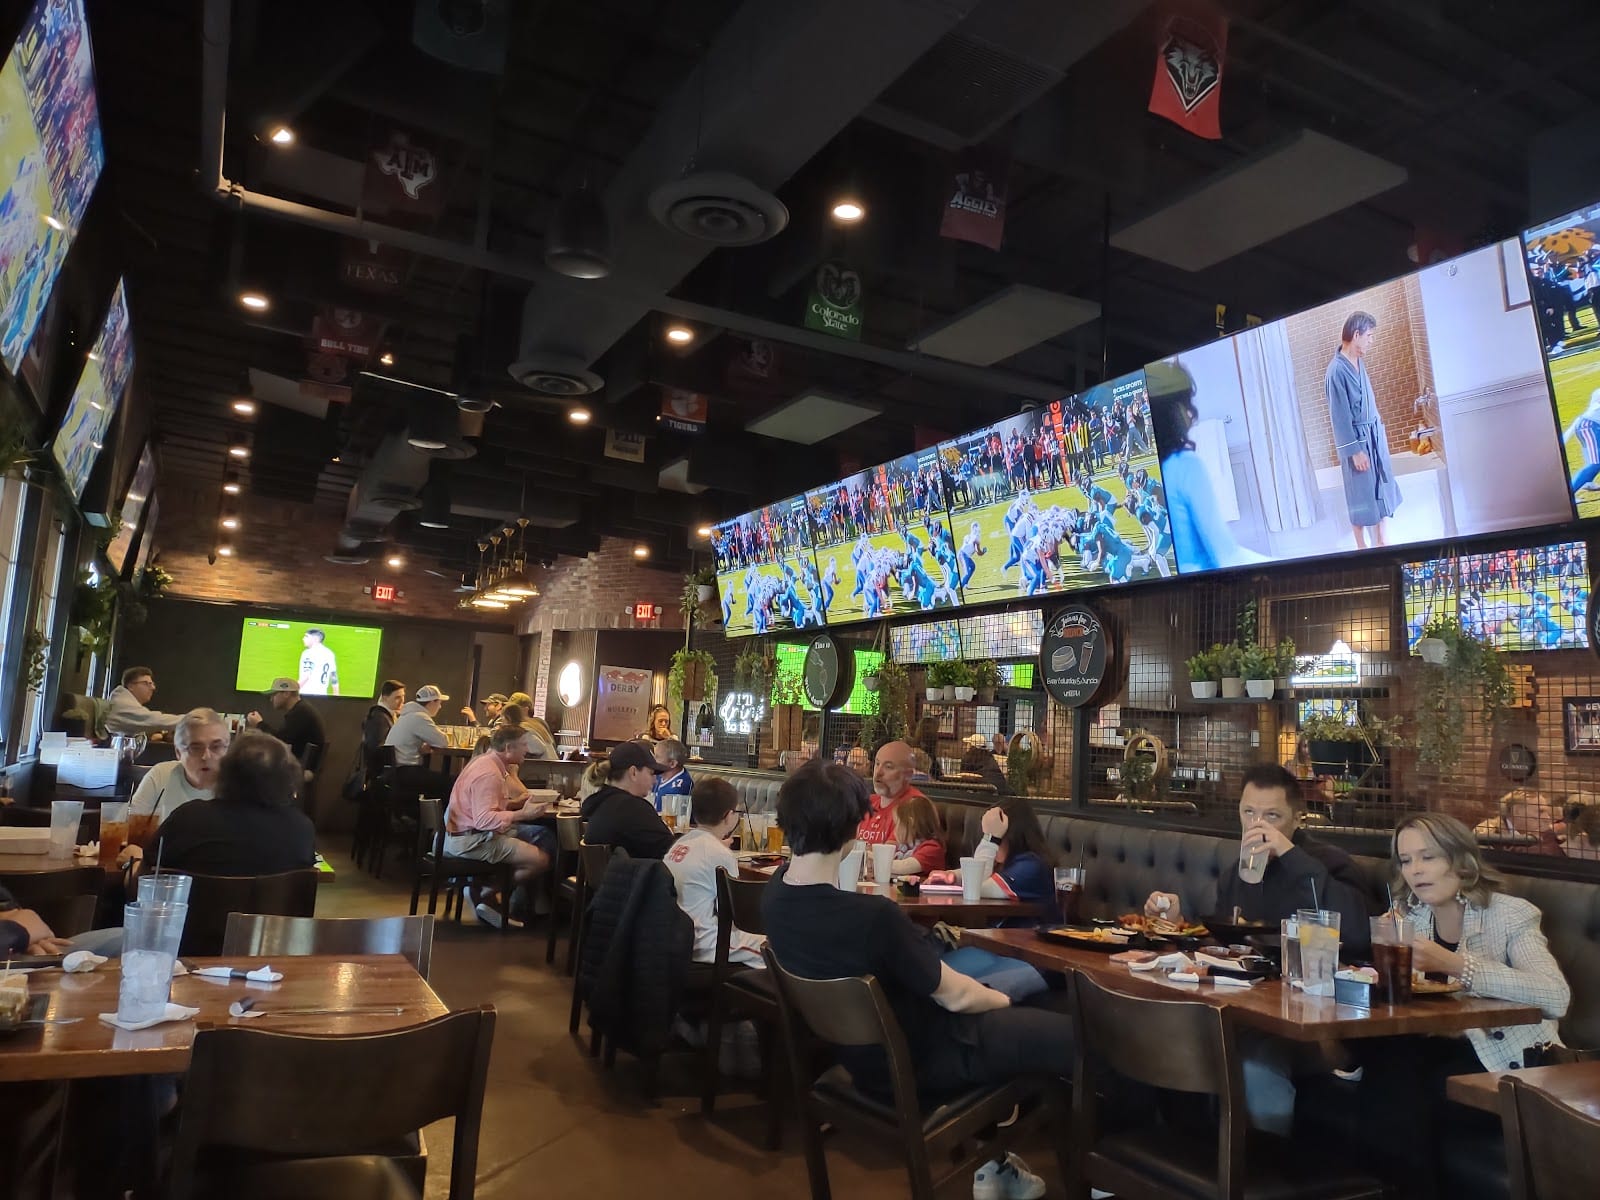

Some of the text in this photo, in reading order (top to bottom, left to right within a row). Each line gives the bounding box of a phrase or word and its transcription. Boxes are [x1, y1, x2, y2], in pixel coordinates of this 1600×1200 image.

[345, 263, 399, 284] TEXAS
[811, 303, 860, 325] Colorado
[822, 314, 848, 331] State
[375, 586, 393, 599] EXIT
[636, 604, 653, 618] EXIT
[610, 683, 640, 694] DERBY
